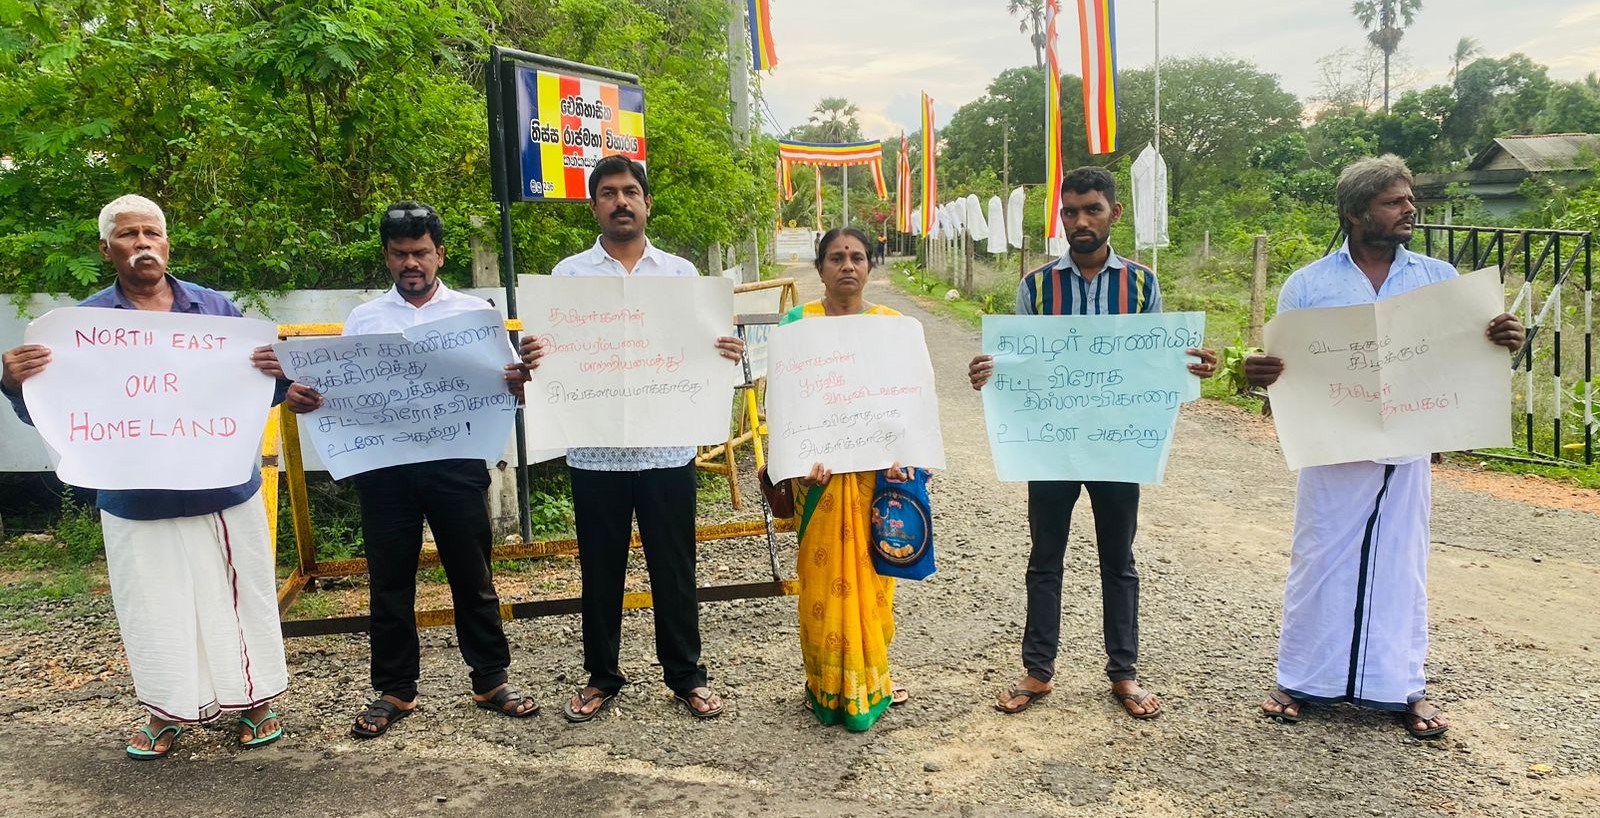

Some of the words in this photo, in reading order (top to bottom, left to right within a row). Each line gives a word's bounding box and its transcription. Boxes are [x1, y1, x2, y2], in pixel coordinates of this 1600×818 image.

[531, 120, 559, 143] තිස්ස
[564, 126, 602, 148] රාජමහා
[606, 130, 638, 153] විහාරය
[549, 307, 645, 328] தமிழர்களின்
[75, 327, 154, 348] NORTH
[172, 333, 228, 350] EAST
[289, 342, 368, 373] தமிழர்
[377, 325, 501, 358] காணிகளை
[994, 328, 1083, 362] தமிழர்
[1089, 327, 1202, 355] காணியில்
[125, 372, 180, 398] OUR
[1329, 383, 1392, 406] தமிழர்
[69, 412, 237, 442] HOMELAND
[997, 422, 1080, 444] உடனே
[1088, 423, 1168, 449] அகற்று
[328, 433, 385, 458] உடனே
